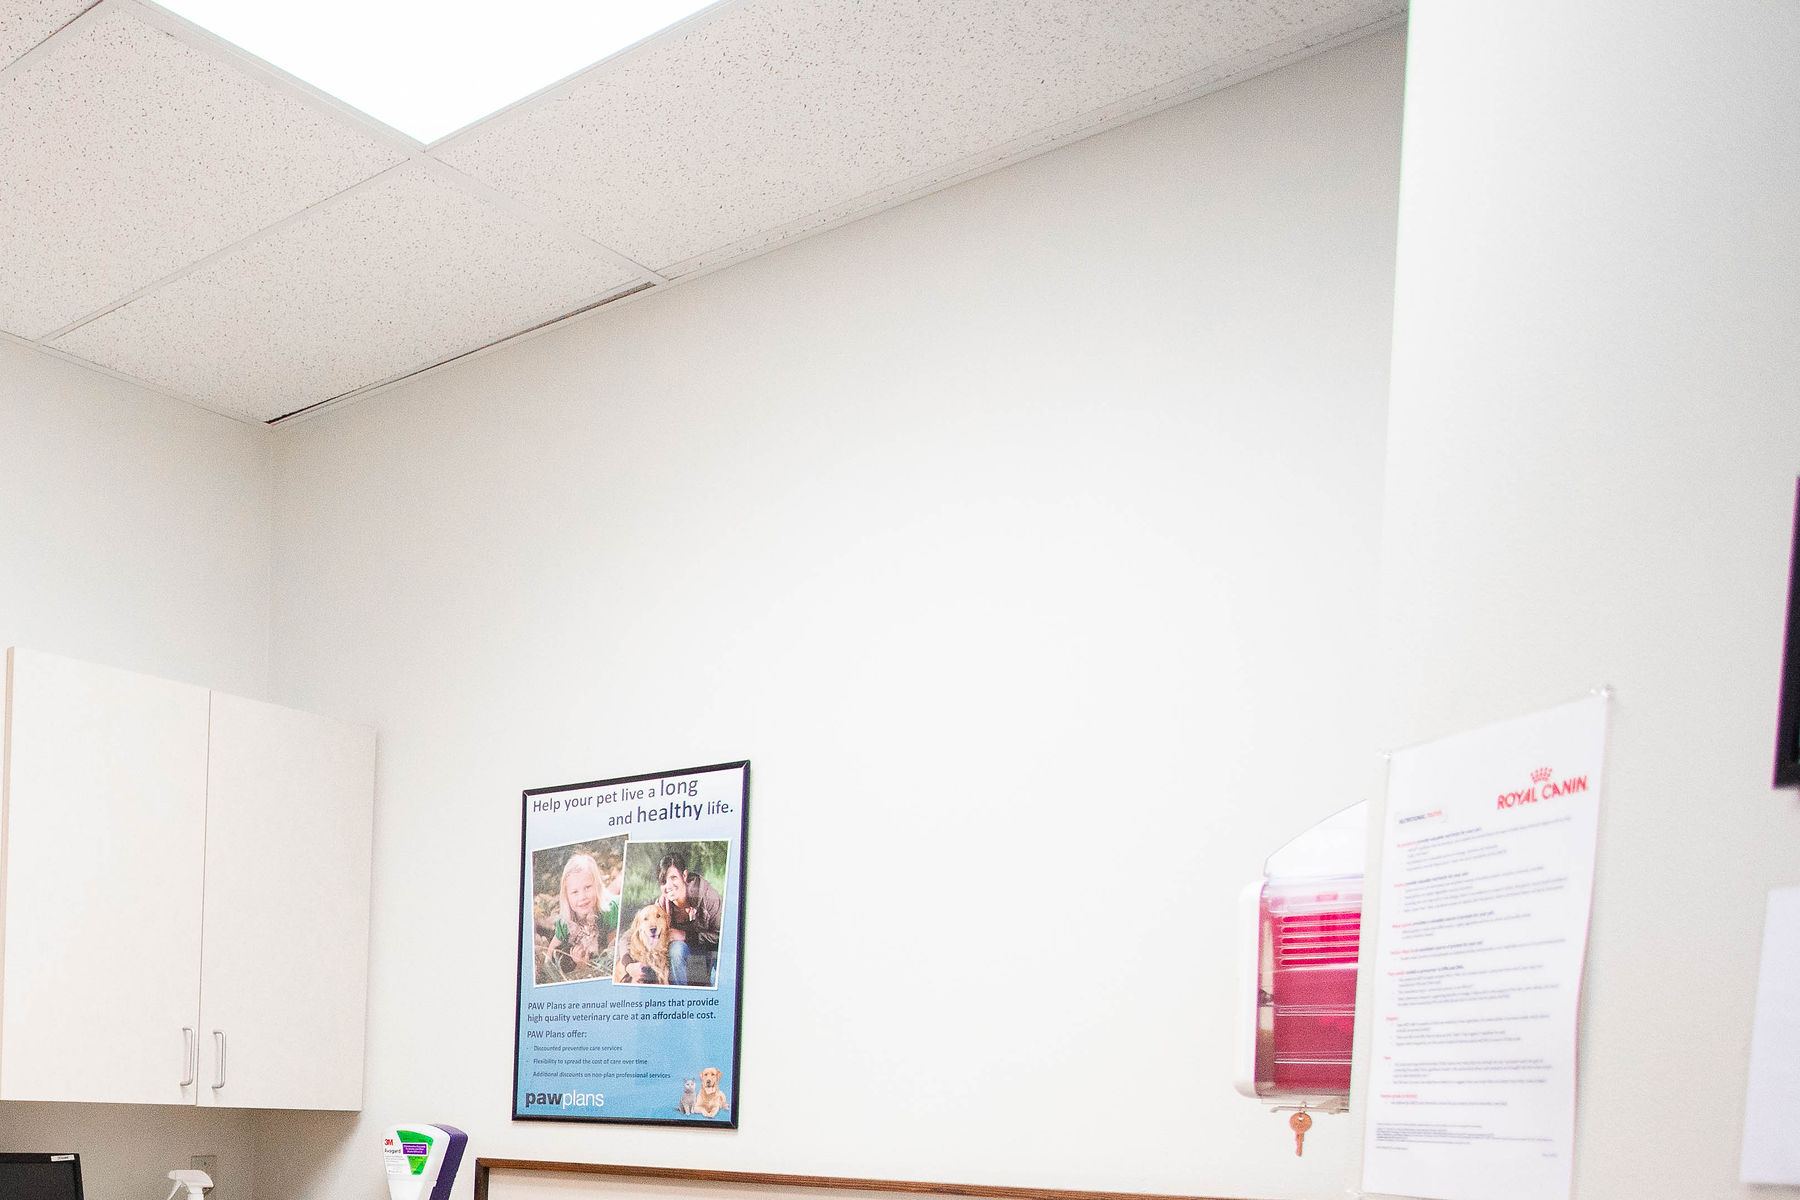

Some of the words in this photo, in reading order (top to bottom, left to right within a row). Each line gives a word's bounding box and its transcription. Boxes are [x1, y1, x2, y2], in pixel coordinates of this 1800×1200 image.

[533, 798, 561, 813] Help
[564, 795, 593, 811] your
[596, 790, 617, 807] pet
[621, 788, 644, 802] live
[648, 787, 656, 798] a
[660, 779, 699, 797] long
[1497, 787, 1538, 811] ROYAL
[1541, 775, 1588, 800] CANIN
[608, 811, 632, 826] and
[637, 801, 703, 823] healthy
[707, 800, 734, 816] life.
[528, 1002, 545, 1010] PAW
[546, 1001, 566, 1010] Plans
[582, 1000, 608, 1009] annual
[610, 999, 643, 1008] wellness
[644, 999, 666, 1009] plans
[668, 998, 685, 1007] that
[687, 998, 719, 1008] provide
[527, 1013, 543, 1023] high
[544, 1013, 571, 1023] quality
[572, 1012, 611, 1022] veterinary
[612, 1013, 629, 1021] care
[652, 1011, 694, 1020] affordable
[696, 1011, 716, 1020] cost.
[527, 1030, 544, 1038] PAW
[545, 1030, 565, 1038] Plans
[566, 1029, 587, 1038] offer:
[525, 1090, 605, 1109] pawplans
[384, 1138, 394, 1146] 3M
